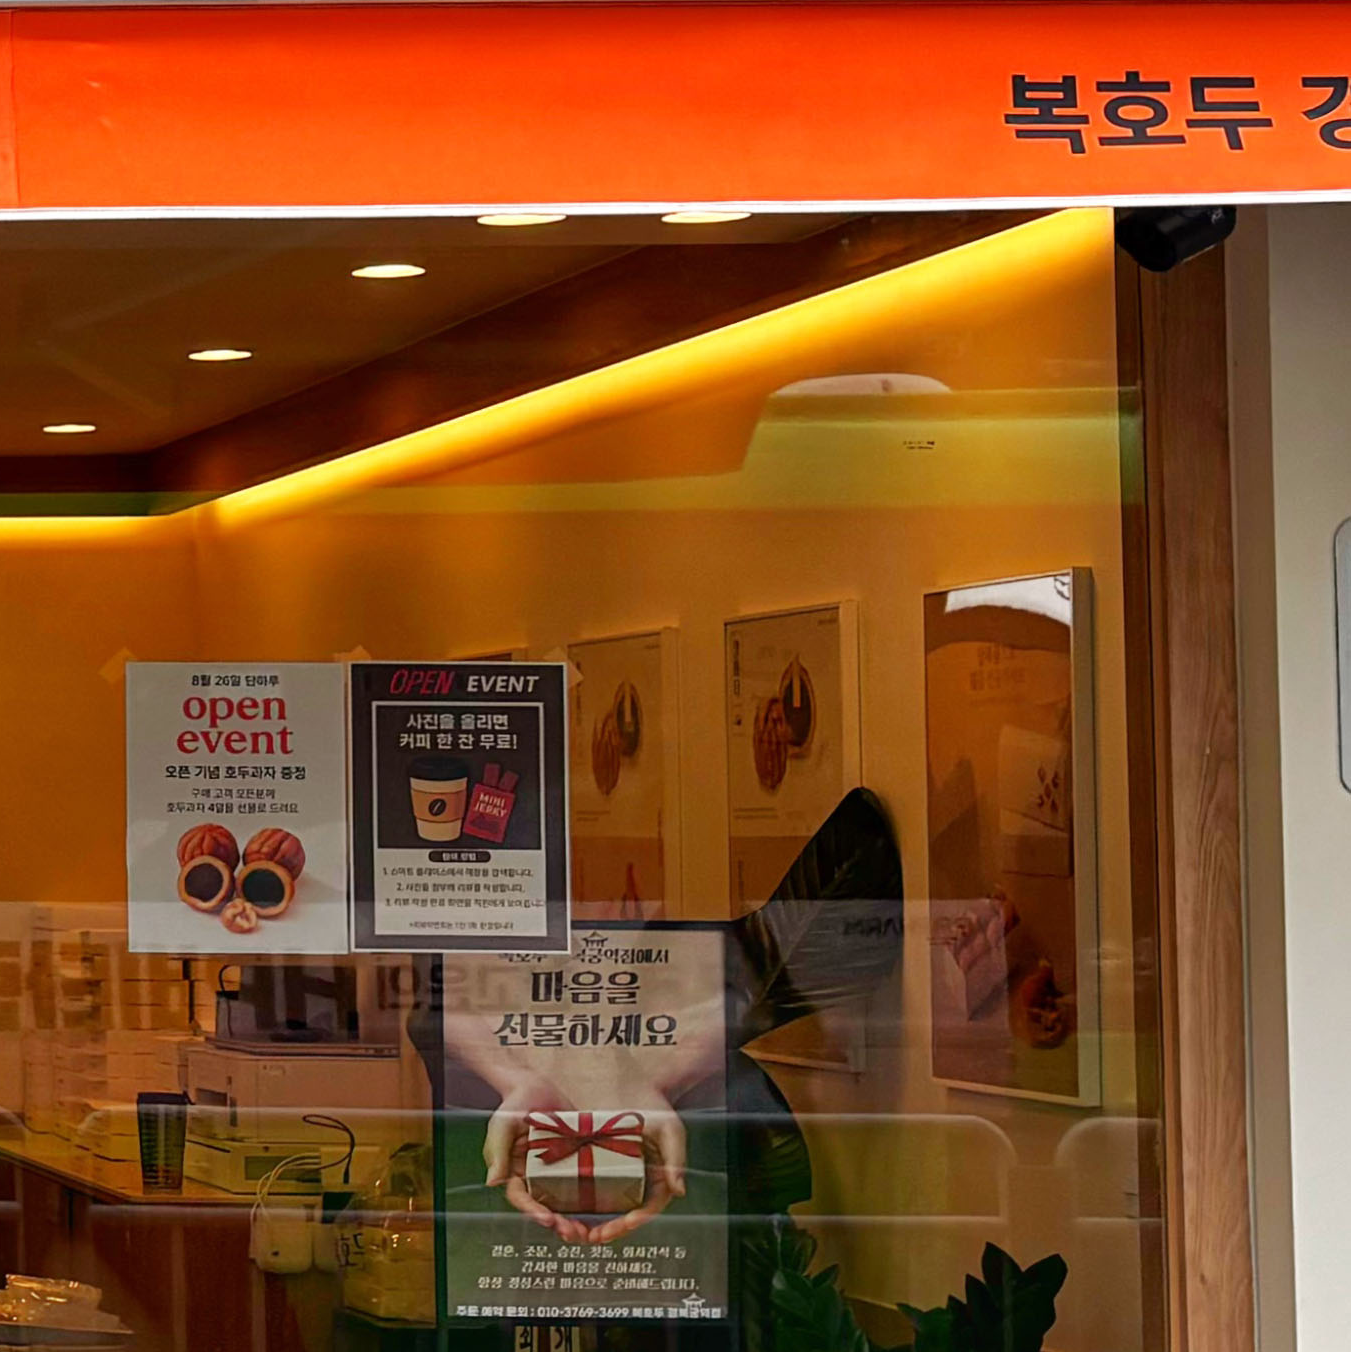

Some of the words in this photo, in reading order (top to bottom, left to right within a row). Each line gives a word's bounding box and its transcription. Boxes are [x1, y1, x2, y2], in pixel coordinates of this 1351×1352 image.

[1004, 70, 1273, 154] 복호두
[191, 675, 211, 687] 8월
[245, 675, 279, 687] 단하루
[390, 669, 455, 694] OPEN
[467, 675, 540, 693] EVENT
[182, 696, 287, 729] open
[406, 714, 454, 730] 사진을
[461, 714, 509, 730] 올리면
[176, 725, 294, 755] event
[399, 734, 431, 749] 커피
[436, 734, 452, 749] 한
[458, 734, 474, 749] 잔
[479, 734, 518, 750] 무료!
[165, 765, 190, 779] 오픈
[194, 765, 220, 779] 기념
[224, 766, 276, 780] 호두과자
[280, 766, 306, 780] 증정
[531, 969, 640, 1005] 마음을
[493, 1012, 677, 1047] 선물하세요
[537, 1306, 630, 1319] 010-3769-3699
